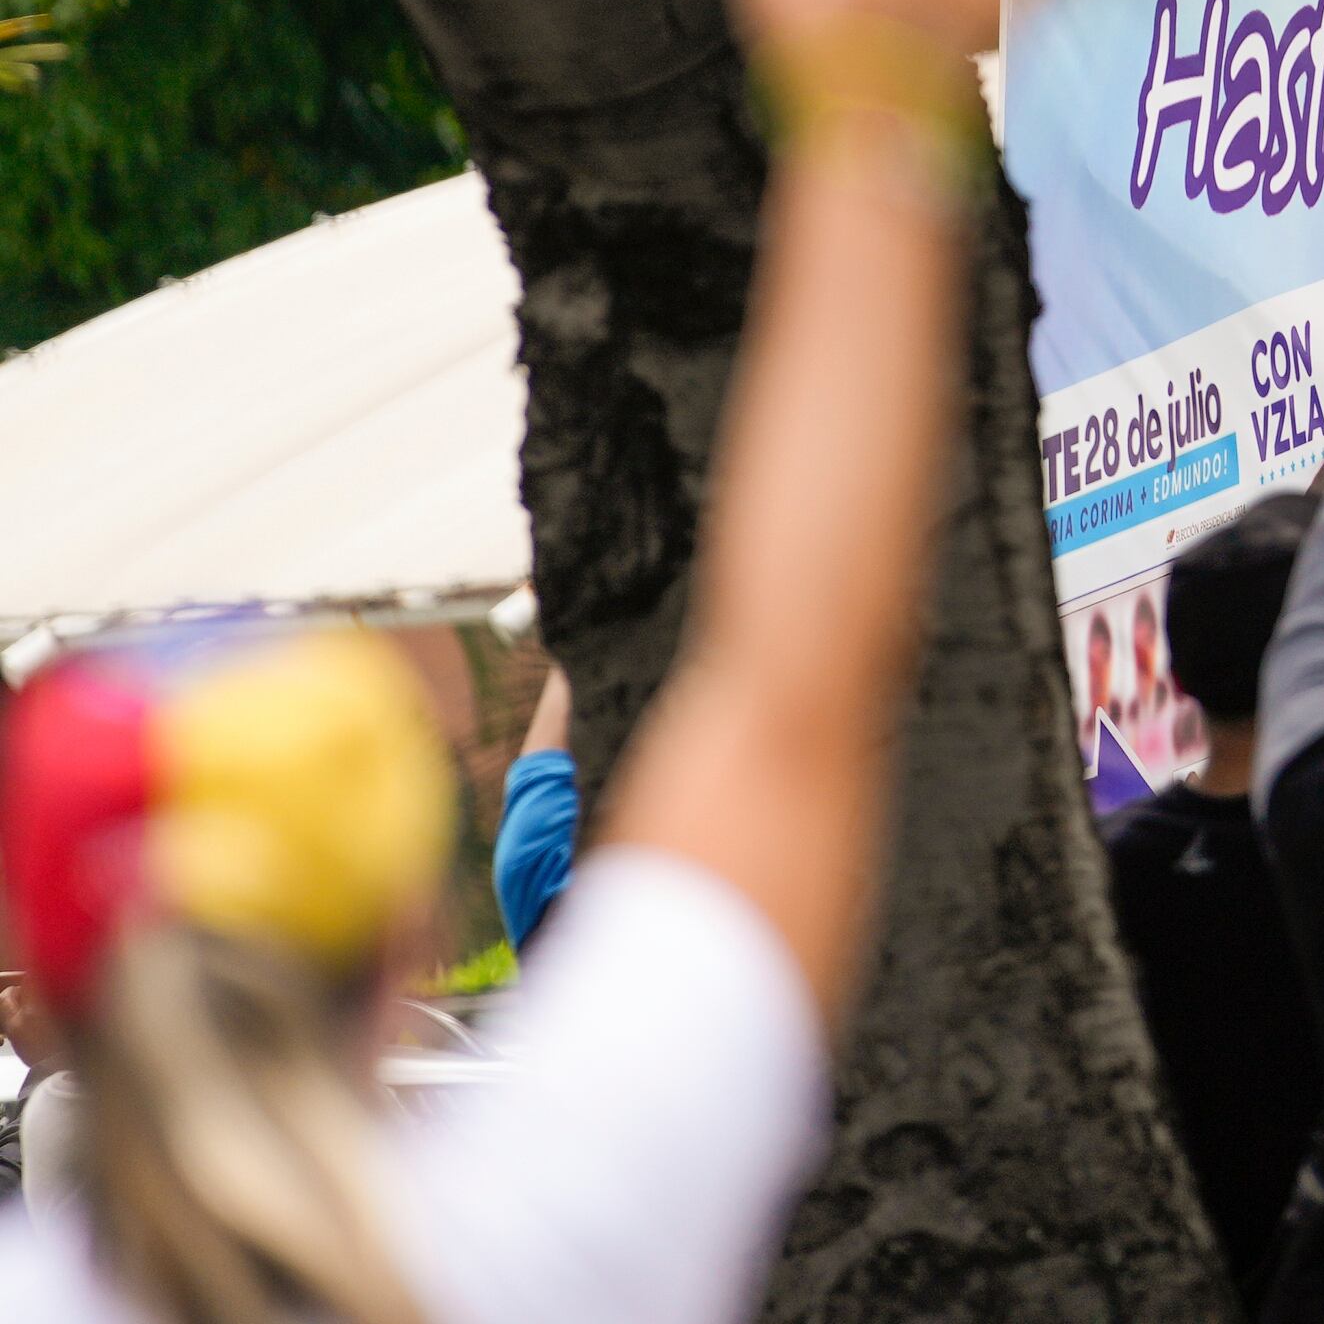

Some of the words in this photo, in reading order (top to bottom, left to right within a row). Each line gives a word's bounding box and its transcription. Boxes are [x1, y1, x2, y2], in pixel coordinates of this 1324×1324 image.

[1251, 319, 1313, 398] CON
[1042, 425, 1081, 503] TE
[1084, 407, 1121, 486] 28
[1127, 393, 1163, 468] de
[1166, 367, 1222, 473] julio
[1049, 513, 1074, 545] RIA
[1079, 487, 1134, 534] CORINA
[1152, 448, 1229, 504] EDMUNDO!
